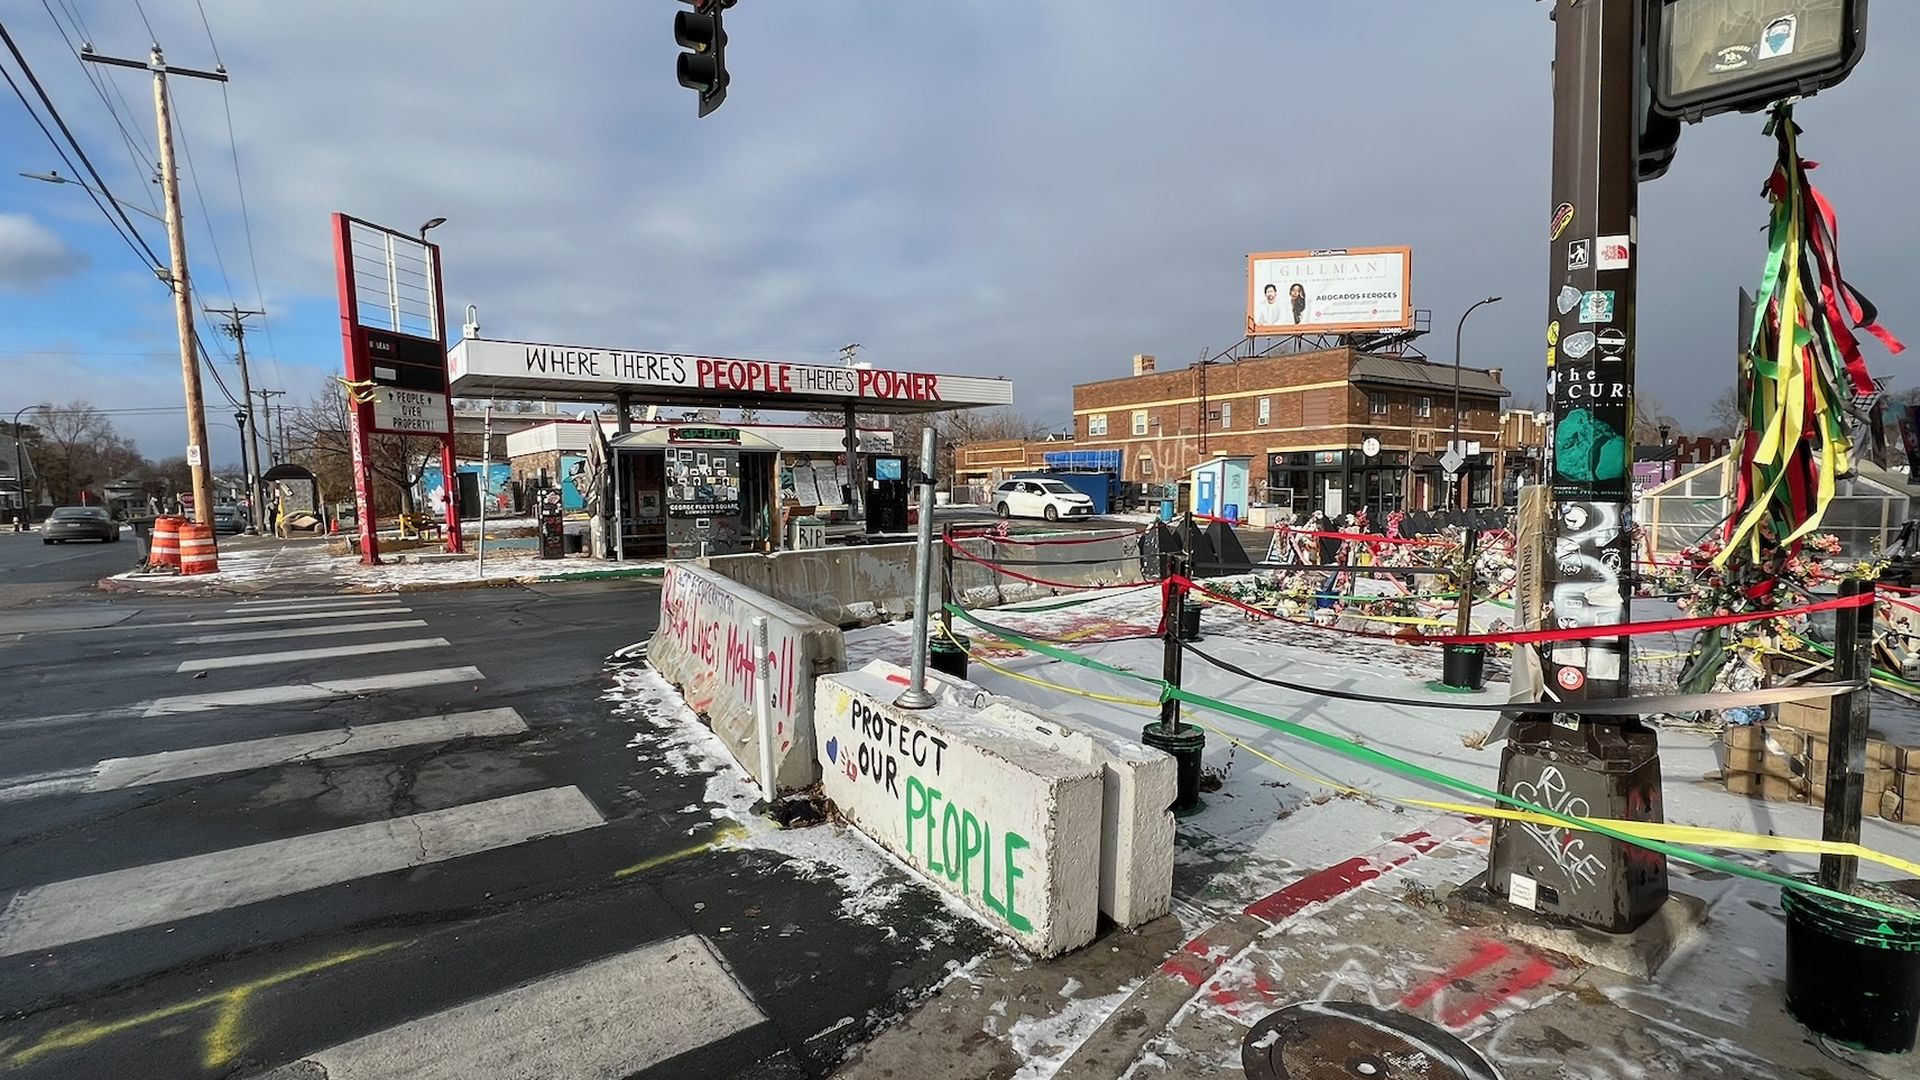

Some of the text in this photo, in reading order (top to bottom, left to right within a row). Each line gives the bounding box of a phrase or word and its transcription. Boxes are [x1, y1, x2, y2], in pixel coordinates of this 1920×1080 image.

[1280, 261, 1378, 277] GILLMAN
[1316, 291, 1398, 302] ABOGADOS FEROCES
[526, 347, 943, 401] WHERE THERE'S PEOPLE THERE'S POWER
[1557, 367, 1596, 382] the
[396, 391, 425, 405] PEOPLE
[402, 405, 422, 417] OVER
[393, 417, 435, 430] PROPERTY!
[669, 503, 695, 512] GEORGE
[716, 503, 740, 512] SQUARE
[799, 528, 823, 549] RIP
[851, 699, 948, 776] PROTECT
[858, 742, 899, 800] OUR
[905, 775, 1034, 934] PEOPLE
